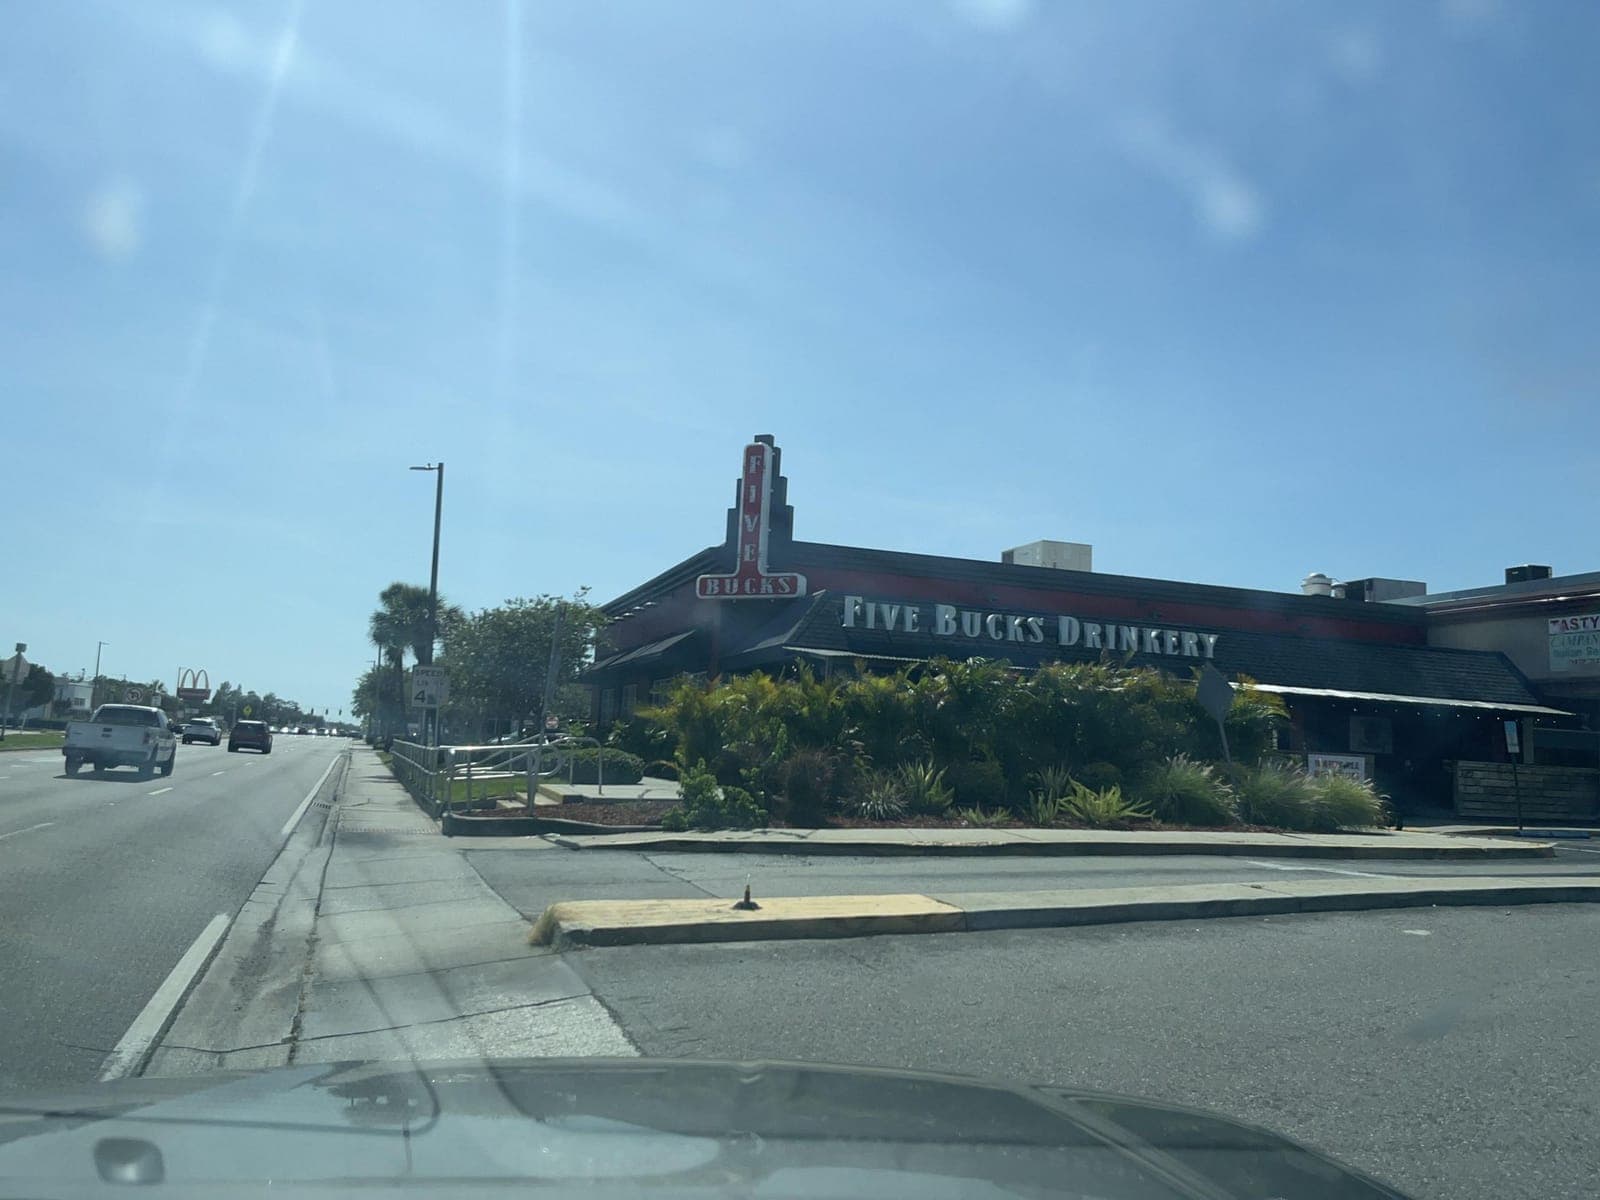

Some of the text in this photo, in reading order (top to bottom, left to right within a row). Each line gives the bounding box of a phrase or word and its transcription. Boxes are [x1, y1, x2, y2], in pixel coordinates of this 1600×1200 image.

[744, 455, 762, 562] FIVE
[705, 576, 791, 595] BUCKS
[843, 595, 1219, 659] FIVE BUCKS DRINKERY
[1550, 615, 1600, 631] TASTY
